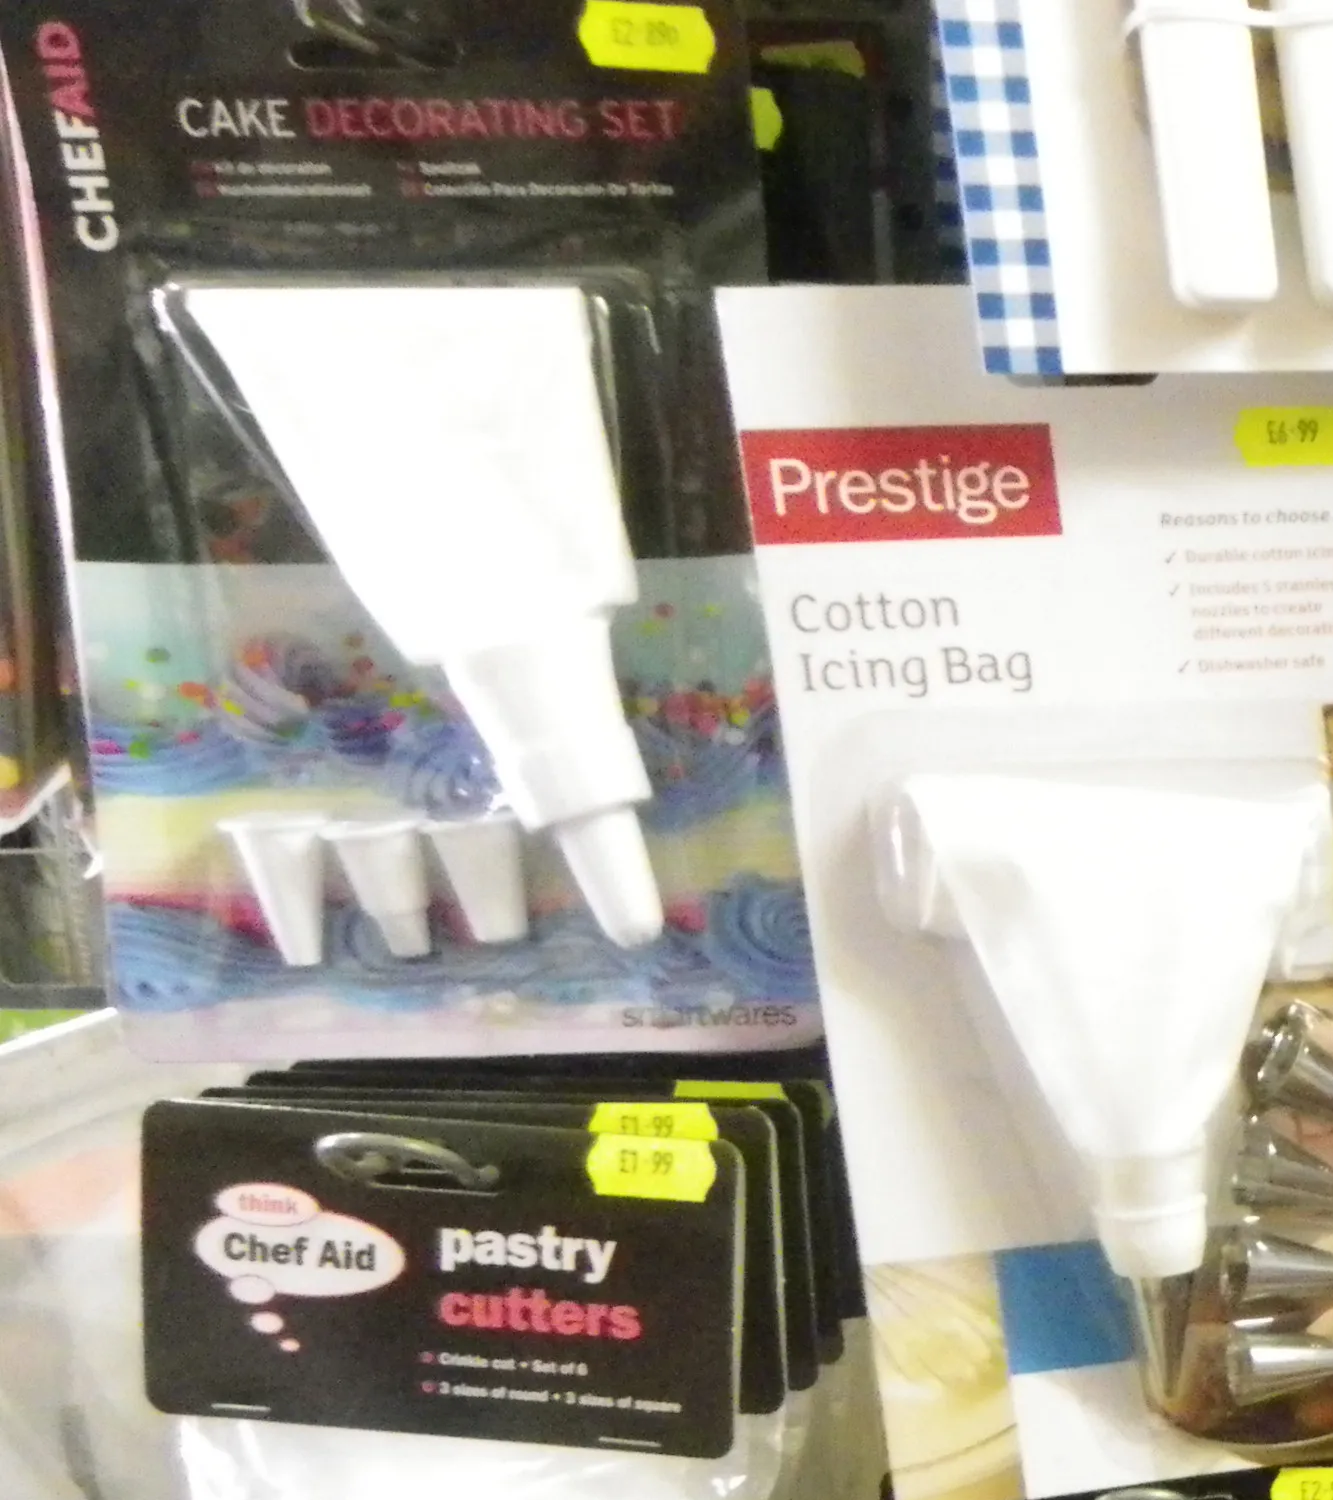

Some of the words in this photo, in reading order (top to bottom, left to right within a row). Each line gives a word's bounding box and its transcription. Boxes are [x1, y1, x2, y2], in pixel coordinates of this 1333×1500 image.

[34, 19, 120, 252] CHEFAID
[178, 99, 296, 138] CAKE
[306, 98, 588, 141] DECORATING
[601, 97, 675, 141] SET
[768, 455, 1030, 525] Prestige
[1160, 511, 1237, 528] Reasons
[1242, 510, 1261, 525] to
[1252, 547, 1303, 561] cotton
[790, 592, 960, 635] Cotton
[800, 648, 929, 699] Icing
[942, 643, 1035, 695] Bag
[237, 1192, 299, 1215] think
[223, 1231, 308, 1266] Chef
[316, 1238, 376, 1272] Aid
[437, 1225, 618, 1281] pastry
[439, 1290, 641, 1341] cutters
[532, 1359, 557, 1374] Set
